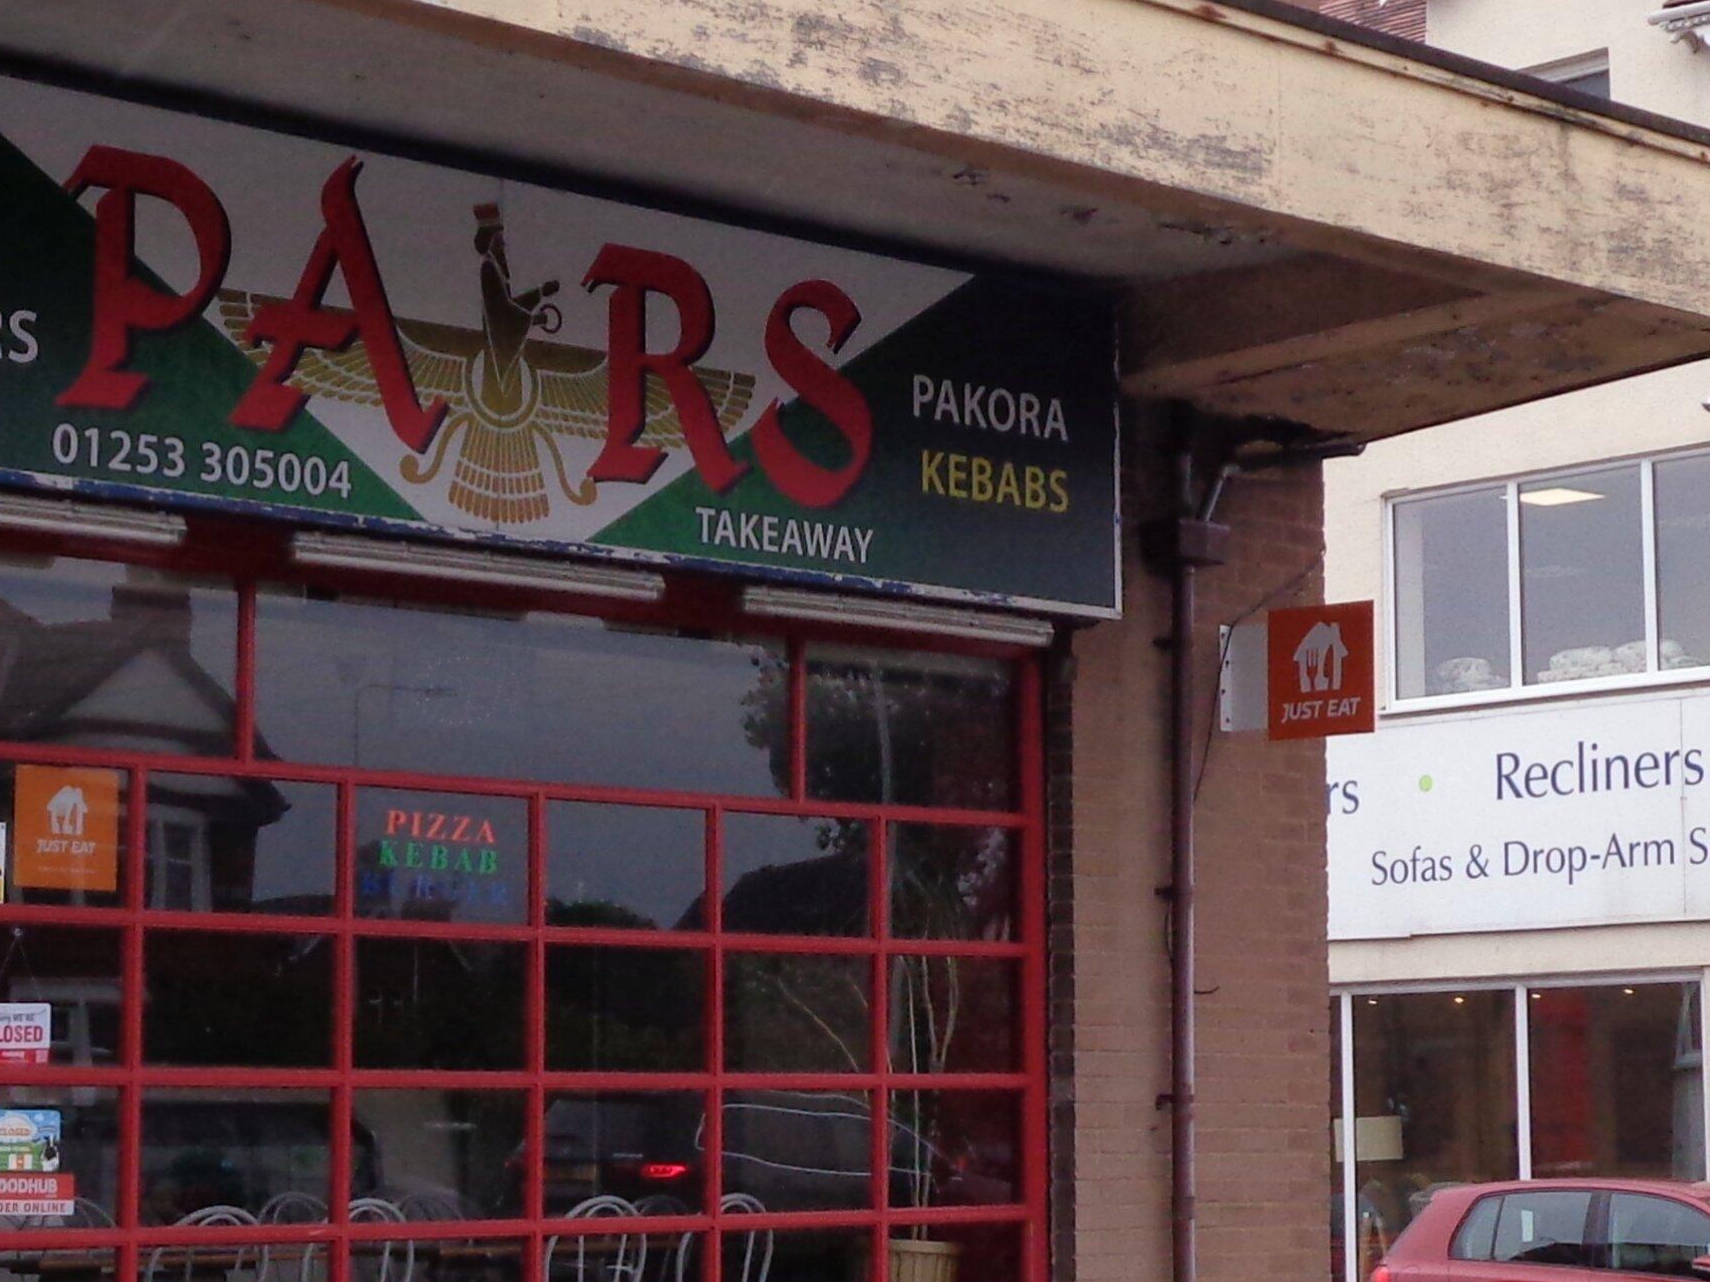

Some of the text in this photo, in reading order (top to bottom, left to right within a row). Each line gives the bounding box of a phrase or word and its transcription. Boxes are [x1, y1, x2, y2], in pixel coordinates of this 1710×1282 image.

[913, 374, 1070, 442] PAKORA
[52, 423, 352, 499] 01253 305004
[920, 450, 1070, 513] KEBABS
[696, 506, 874, 565] TAKEAWAY
[1281, 697, 1361, 723] JUST EAT
[1496, 741, 1705, 801] Recliners
[36, 839, 97, 854] JUST EAT
[385, 809, 496, 844] PIZZA
[380, 840, 499, 874] KEBAB
[1371, 845, 1453, 886] Sofas
[1466, 844, 1490, 880] &
[1503, 833, 1676, 885] Drop-Arm
[23, 1202, 66, 1213] ONLINE
